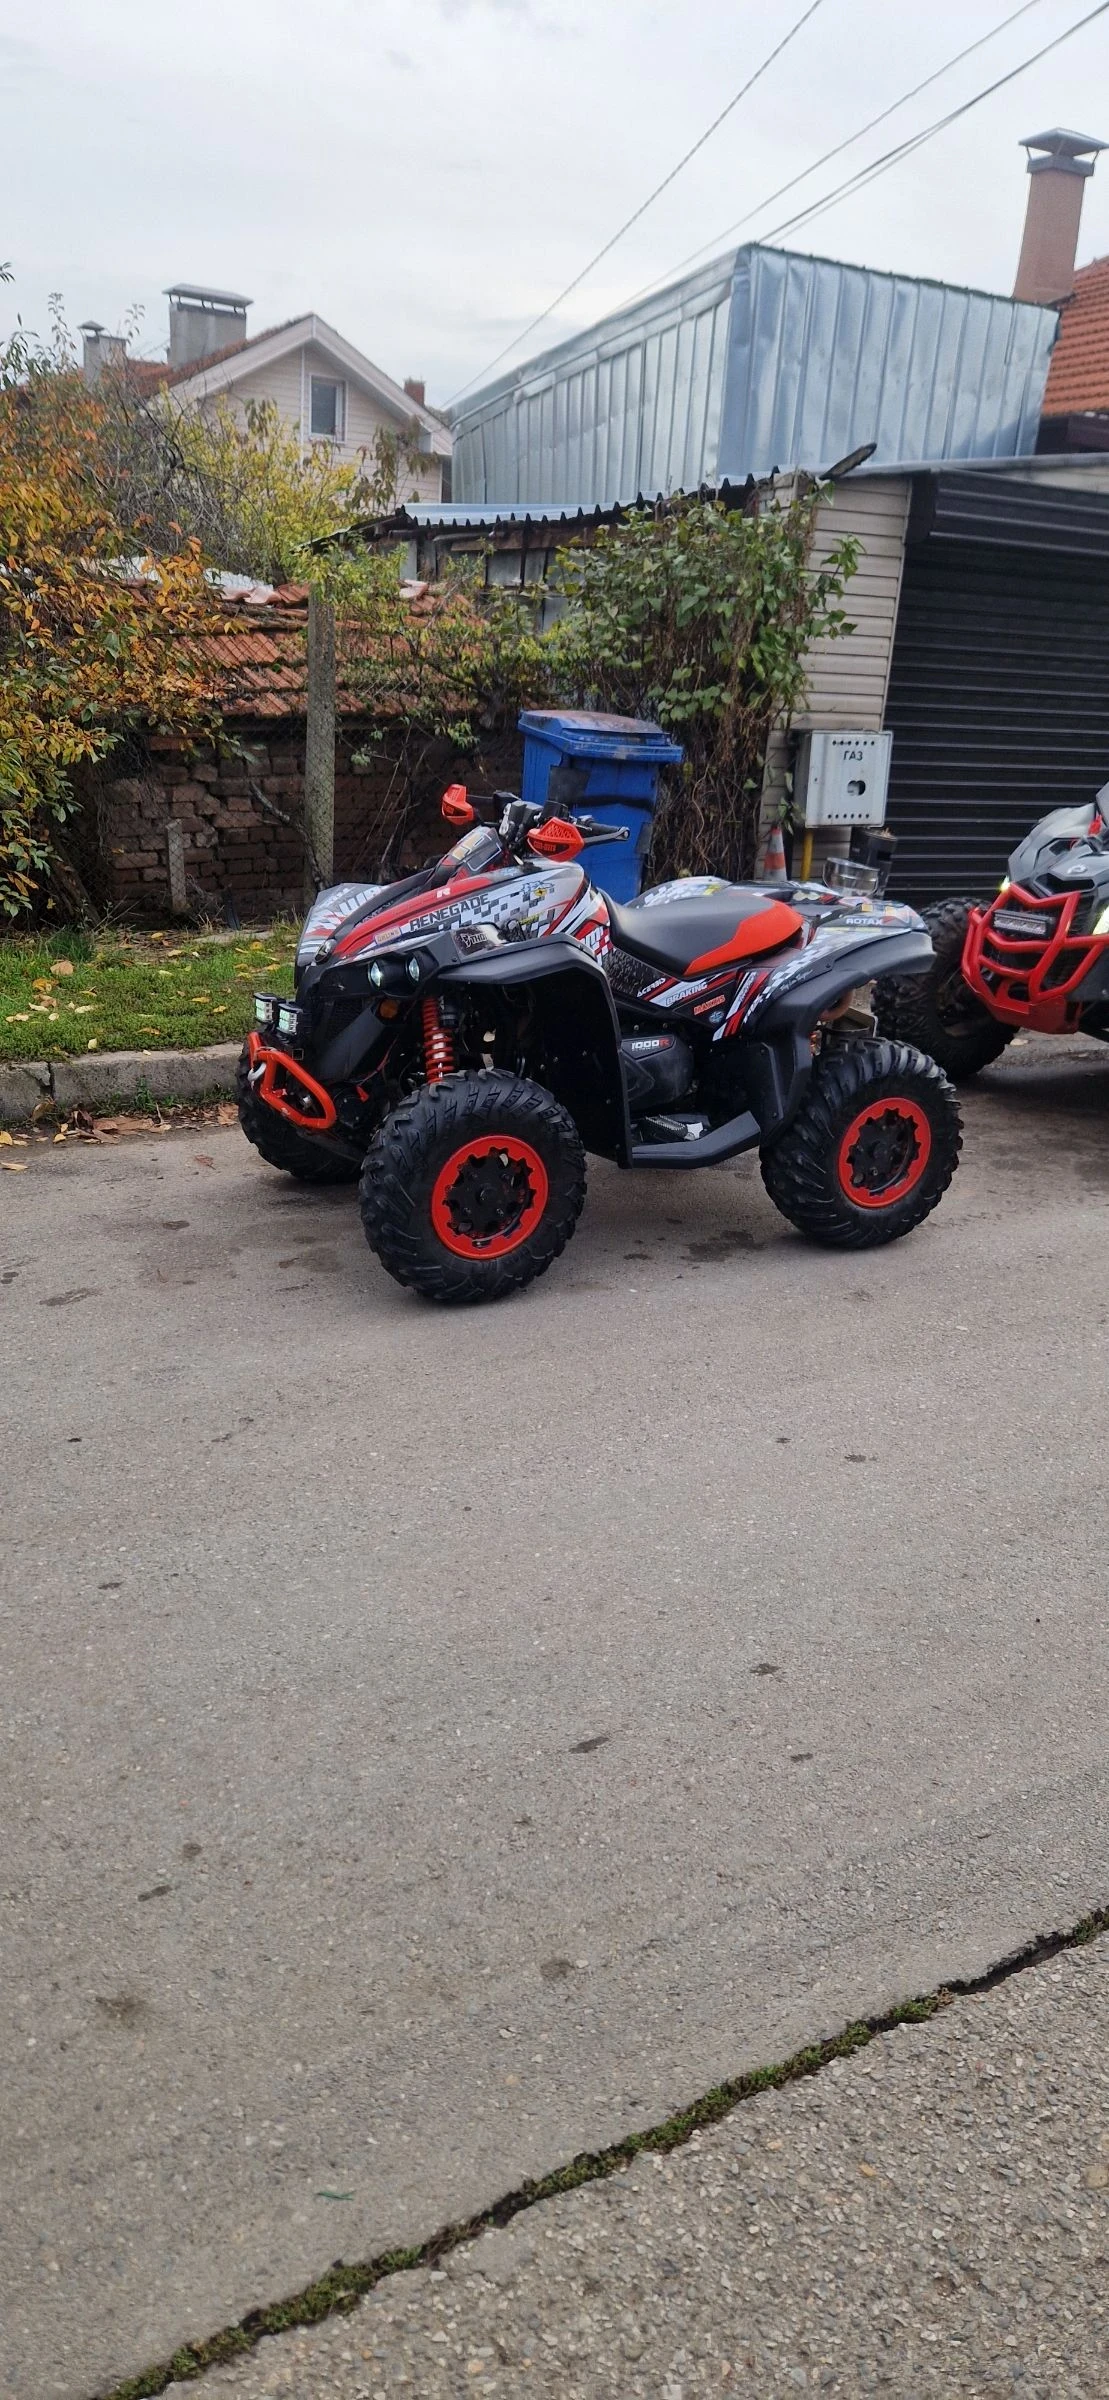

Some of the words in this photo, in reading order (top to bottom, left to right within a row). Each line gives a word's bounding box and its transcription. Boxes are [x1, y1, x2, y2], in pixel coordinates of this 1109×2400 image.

[843, 750, 863, 761] ГАЗ
[410, 893, 490, 931] RENEGADE
[666, 982, 708, 1005] BRAKING
[631, 1038, 669, 1049] 1000R
